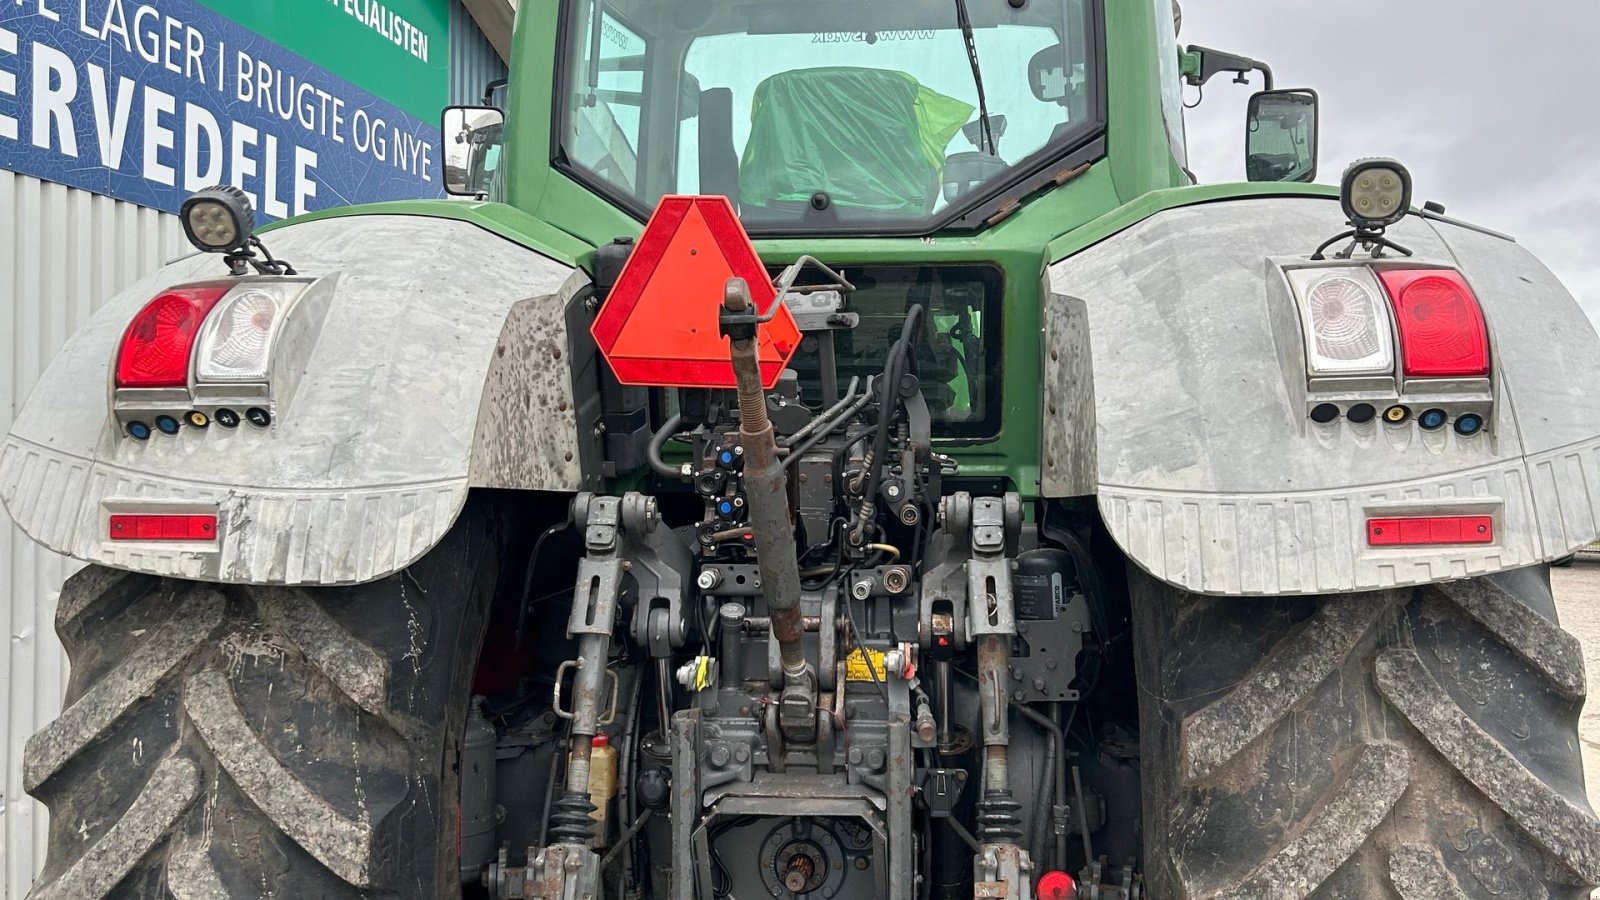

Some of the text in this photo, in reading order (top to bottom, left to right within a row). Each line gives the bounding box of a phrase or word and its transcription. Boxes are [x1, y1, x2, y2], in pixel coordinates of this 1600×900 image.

[80, 0, 432, 182] LAGER I BRUGTE OG NYE
[333, 0, 428, 63] CIALISTEN
